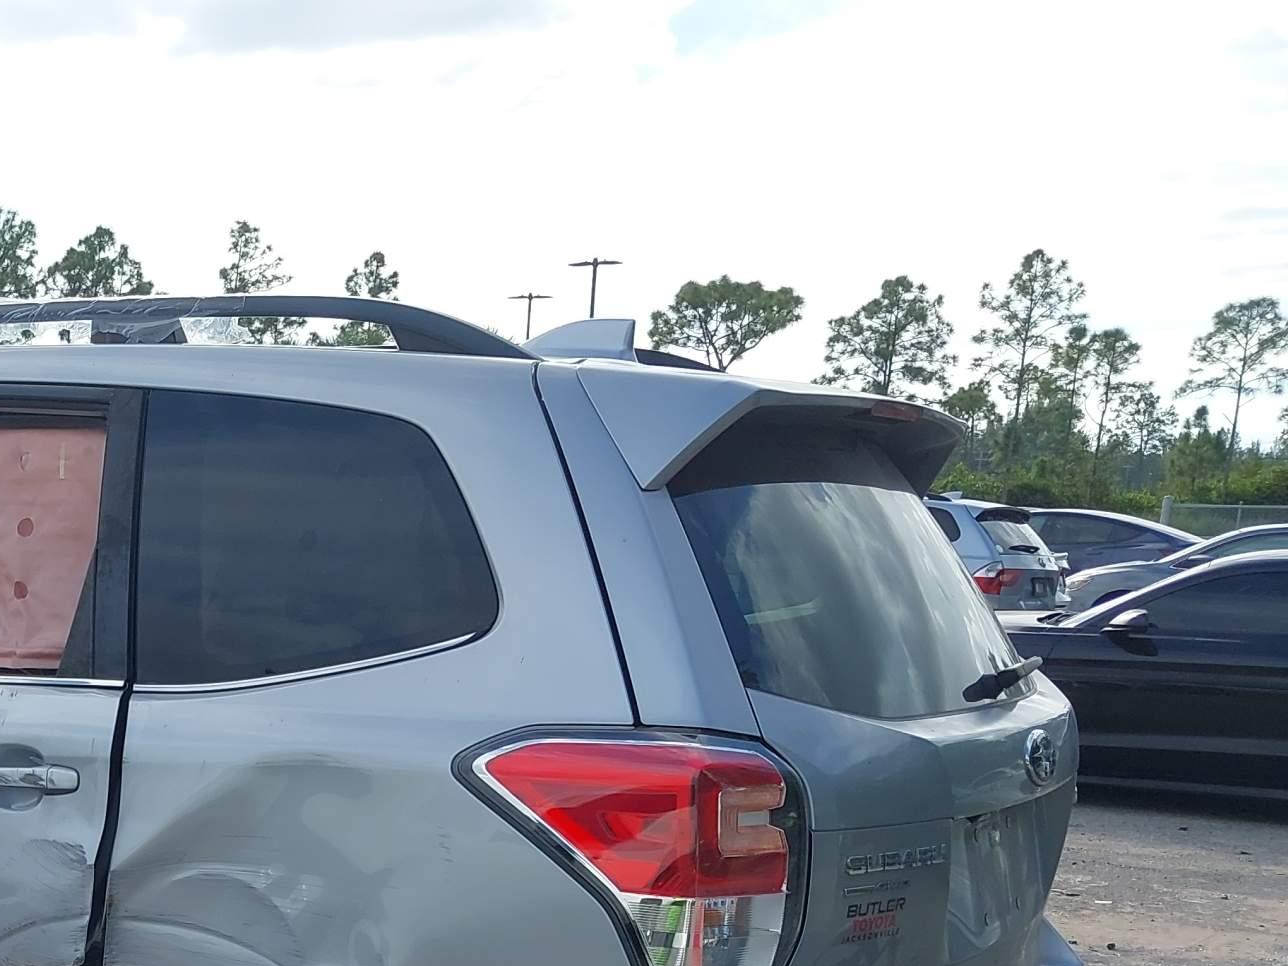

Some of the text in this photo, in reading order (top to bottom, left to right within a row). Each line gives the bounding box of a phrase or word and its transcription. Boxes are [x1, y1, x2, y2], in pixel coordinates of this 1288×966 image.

[846, 843, 946, 875] SUBARU
[846, 897, 907, 919] BUTLER
[852, 913, 897, 934] TOYOTA
